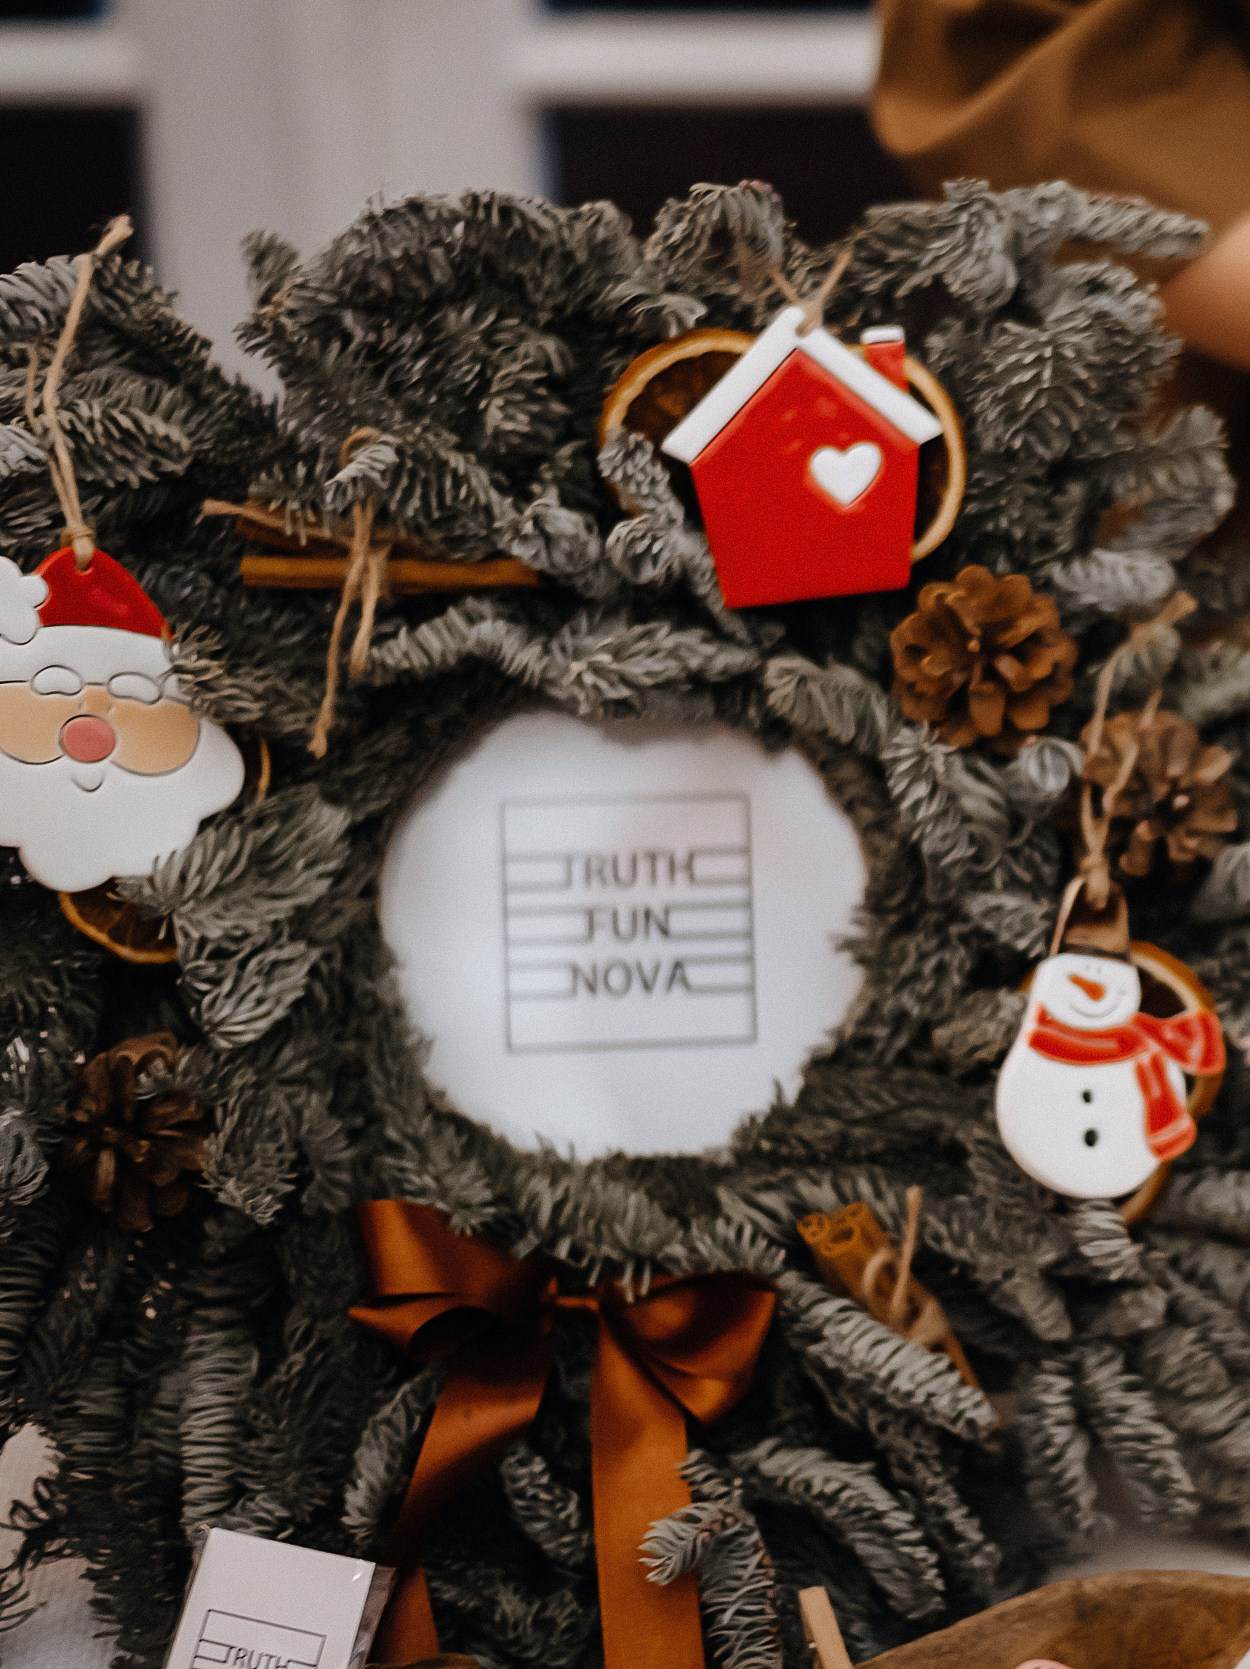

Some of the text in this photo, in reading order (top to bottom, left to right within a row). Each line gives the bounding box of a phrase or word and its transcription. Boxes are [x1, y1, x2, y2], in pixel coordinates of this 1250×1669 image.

[561, 850, 697, 890] TRUTH
[585, 903, 671, 942] FUN
[570, 957, 692, 996] NOVA
